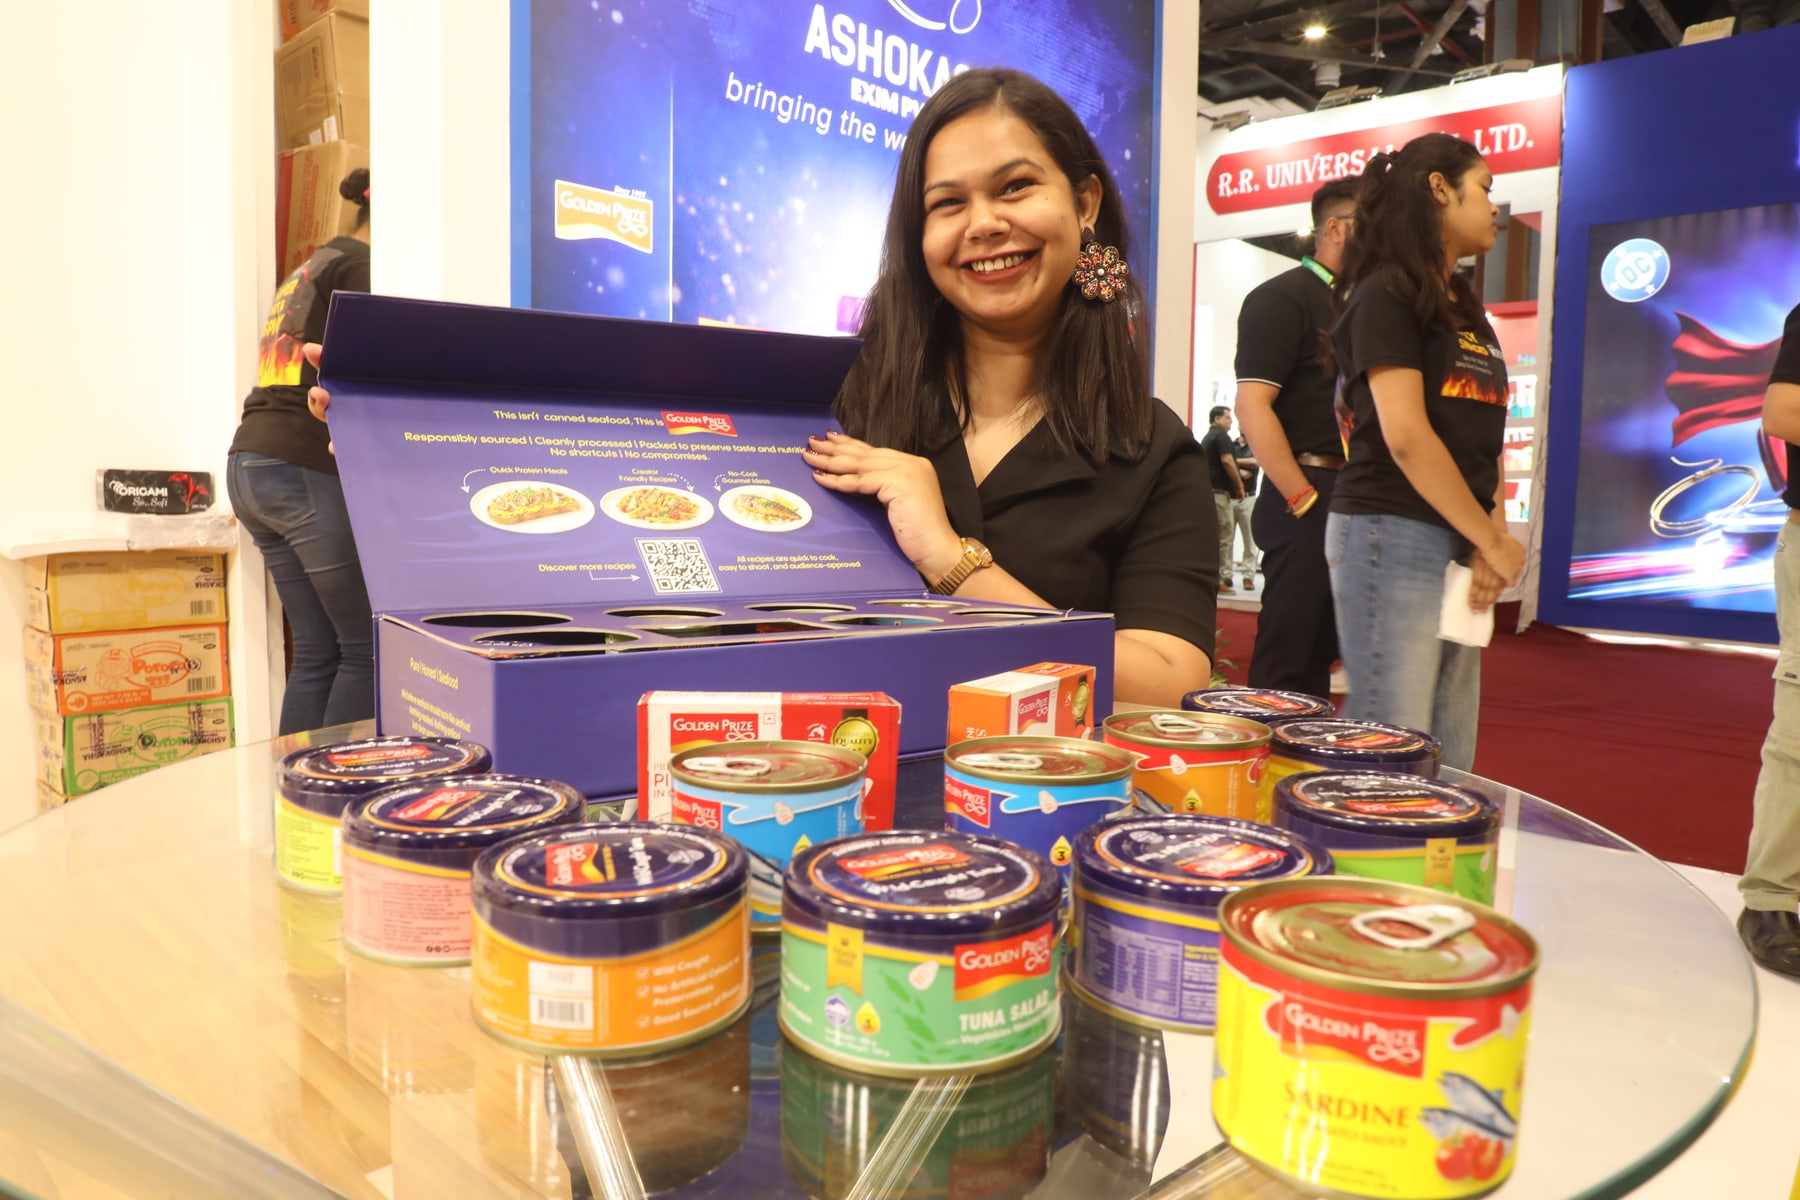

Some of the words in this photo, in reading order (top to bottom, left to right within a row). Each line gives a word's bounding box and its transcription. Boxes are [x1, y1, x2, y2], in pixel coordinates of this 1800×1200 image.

[804, 4, 971, 98] ASHOKA
[850, 77, 899, 116] EXIM
[725, 72, 833, 136] bringing
[839, 110, 877, 143] the
[1218, 168, 1261, 197] R.R.
[1265, 145, 1394, 189] UNIVERS
[1473, 123, 1534, 155] LTD.
[560, 190, 611, 217] GOLDEN
[613, 201, 647, 224] PRIZE
[1620, 256, 1652, 285] DC
[493, 410, 517, 420] This
[518, 411, 540, 421] isn't
[543, 413, 586, 423] canned
[635, 416, 656, 426] This
[657, 418, 665, 427] is
[666, 413, 703, 425] GOLDEN
[703, 415, 727, 428] PRIZE
[404, 431, 478, 445] Responsibly
[480, 435, 527, 445] sourced
[535, 436, 575, 448] Cleanly
[577, 437, 633, 449] processed
[639, 440, 677, 450] Packed
[678, 442, 688, 451] to
[690, 444, 732, 453] preserve
[733, 444, 757, 453] taste
[758, 445, 776, 453] and
[550, 448, 567, 457] No
[569, 449, 618, 458] shortcuts
[625, 450, 640, 459] No
[641, 452, 710, 462] compromises.
[489, 466, 514, 475] Quick
[514, 466, 543, 475] Protein
[543, 467, 569, 476] Meals
[618, 475, 648, 484] Friendly
[648, 475, 678, 484] Recipes
[118, 485, 168, 498] ORIGAMI
[538, 563, 578, 572] Discover
[604, 562, 637, 572] recipes
[718, 565, 738, 573] easy
[773, 562, 789, 570] and
[747, 555, 775, 564] recipes
[789, 554, 809, 563] quick
[809, 554, 818, 562] to
[1019, 701, 1036, 716] GOLDEN
[1036, 697, 1049, 708] PRIZE
[673, 717, 720, 732] GOLDEN
[721, 719, 754, 734] PRIZE
[835, 737, 872, 747] QUALITY
[963, 789, 985, 806] PRIZE
[1189, 802, 1195, 810] 3
[692, 802, 717, 820] PRIZE
[846, 855, 905, 868] GOLDEN
[1058, 851, 1065, 860] 3
[960, 948, 1020, 970] GOLDEN
[1022, 934, 1050, 958] PRIZE
[652, 964, 676, 977] Wild
[677, 954, 710, 972] Caught
[652, 985, 668, 994] No
[670, 972, 708, 991] Artificial
[652, 984, 715, 1008] Preservatives
[653, 1011, 681, 1025] Good
[682, 1002, 712, 1018] Source
[959, 1008, 1005, 1033] TUNA
[1284, 1003, 1359, 1038] GOLDEN
[1362, 1021, 1419, 1048] PRIZE
[960, 1028, 1012, 1045] Vegetables
[1283, 1081, 1412, 1128] SARDINE
